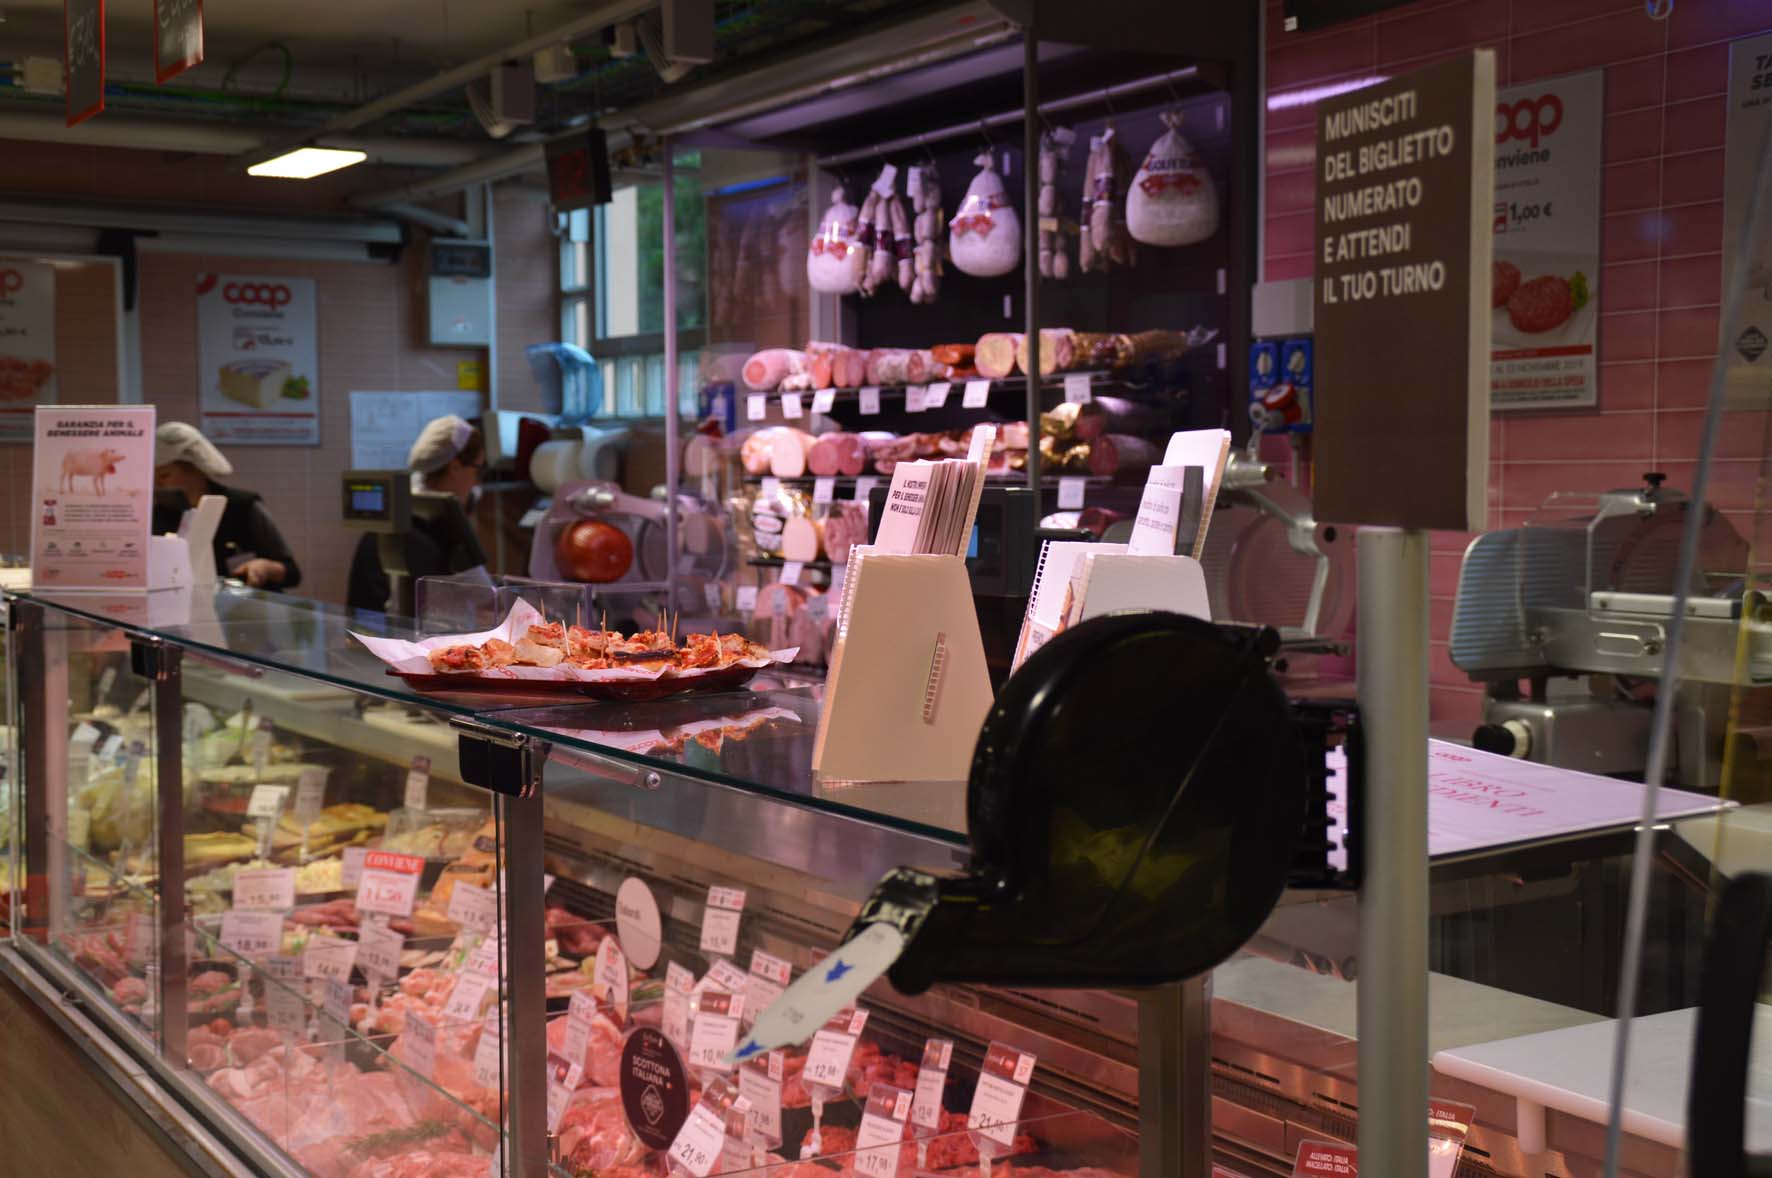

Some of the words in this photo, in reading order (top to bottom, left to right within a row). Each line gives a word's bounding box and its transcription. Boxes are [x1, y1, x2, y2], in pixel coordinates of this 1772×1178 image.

[1325, 89, 1417, 142] MUNISCITI
[1495, 93, 1564, 149] oop
[1324, 151, 1356, 183] DEL
[1358, 124, 1455, 175] BIGLIETTO
[1496, 149, 1551, 169] nviene
[1324, 177, 1423, 223] NUMERATO
[1510, 203, 1540, 224] 1,00
[1543, 202, 1553, 217] €
[1324, 236, 1334, 263] E
[1336, 221, 1411, 262] ATTENDI
[222, 282, 292, 310] coop
[1323, 277, 1338, 304] IL
[1340, 270, 1377, 301] TUO
[1379, 260, 1446, 296] TURNO
[47, 430, 100, 438] BENESSERE
[102, 429, 145, 438] ANIMALE
[57, 420, 104, 429] GARANZIA
[106, 420, 125, 429] PER
[632, 1055, 670, 1078] SCOTTONA
[632, 1066, 664, 1087] ITALIANA
